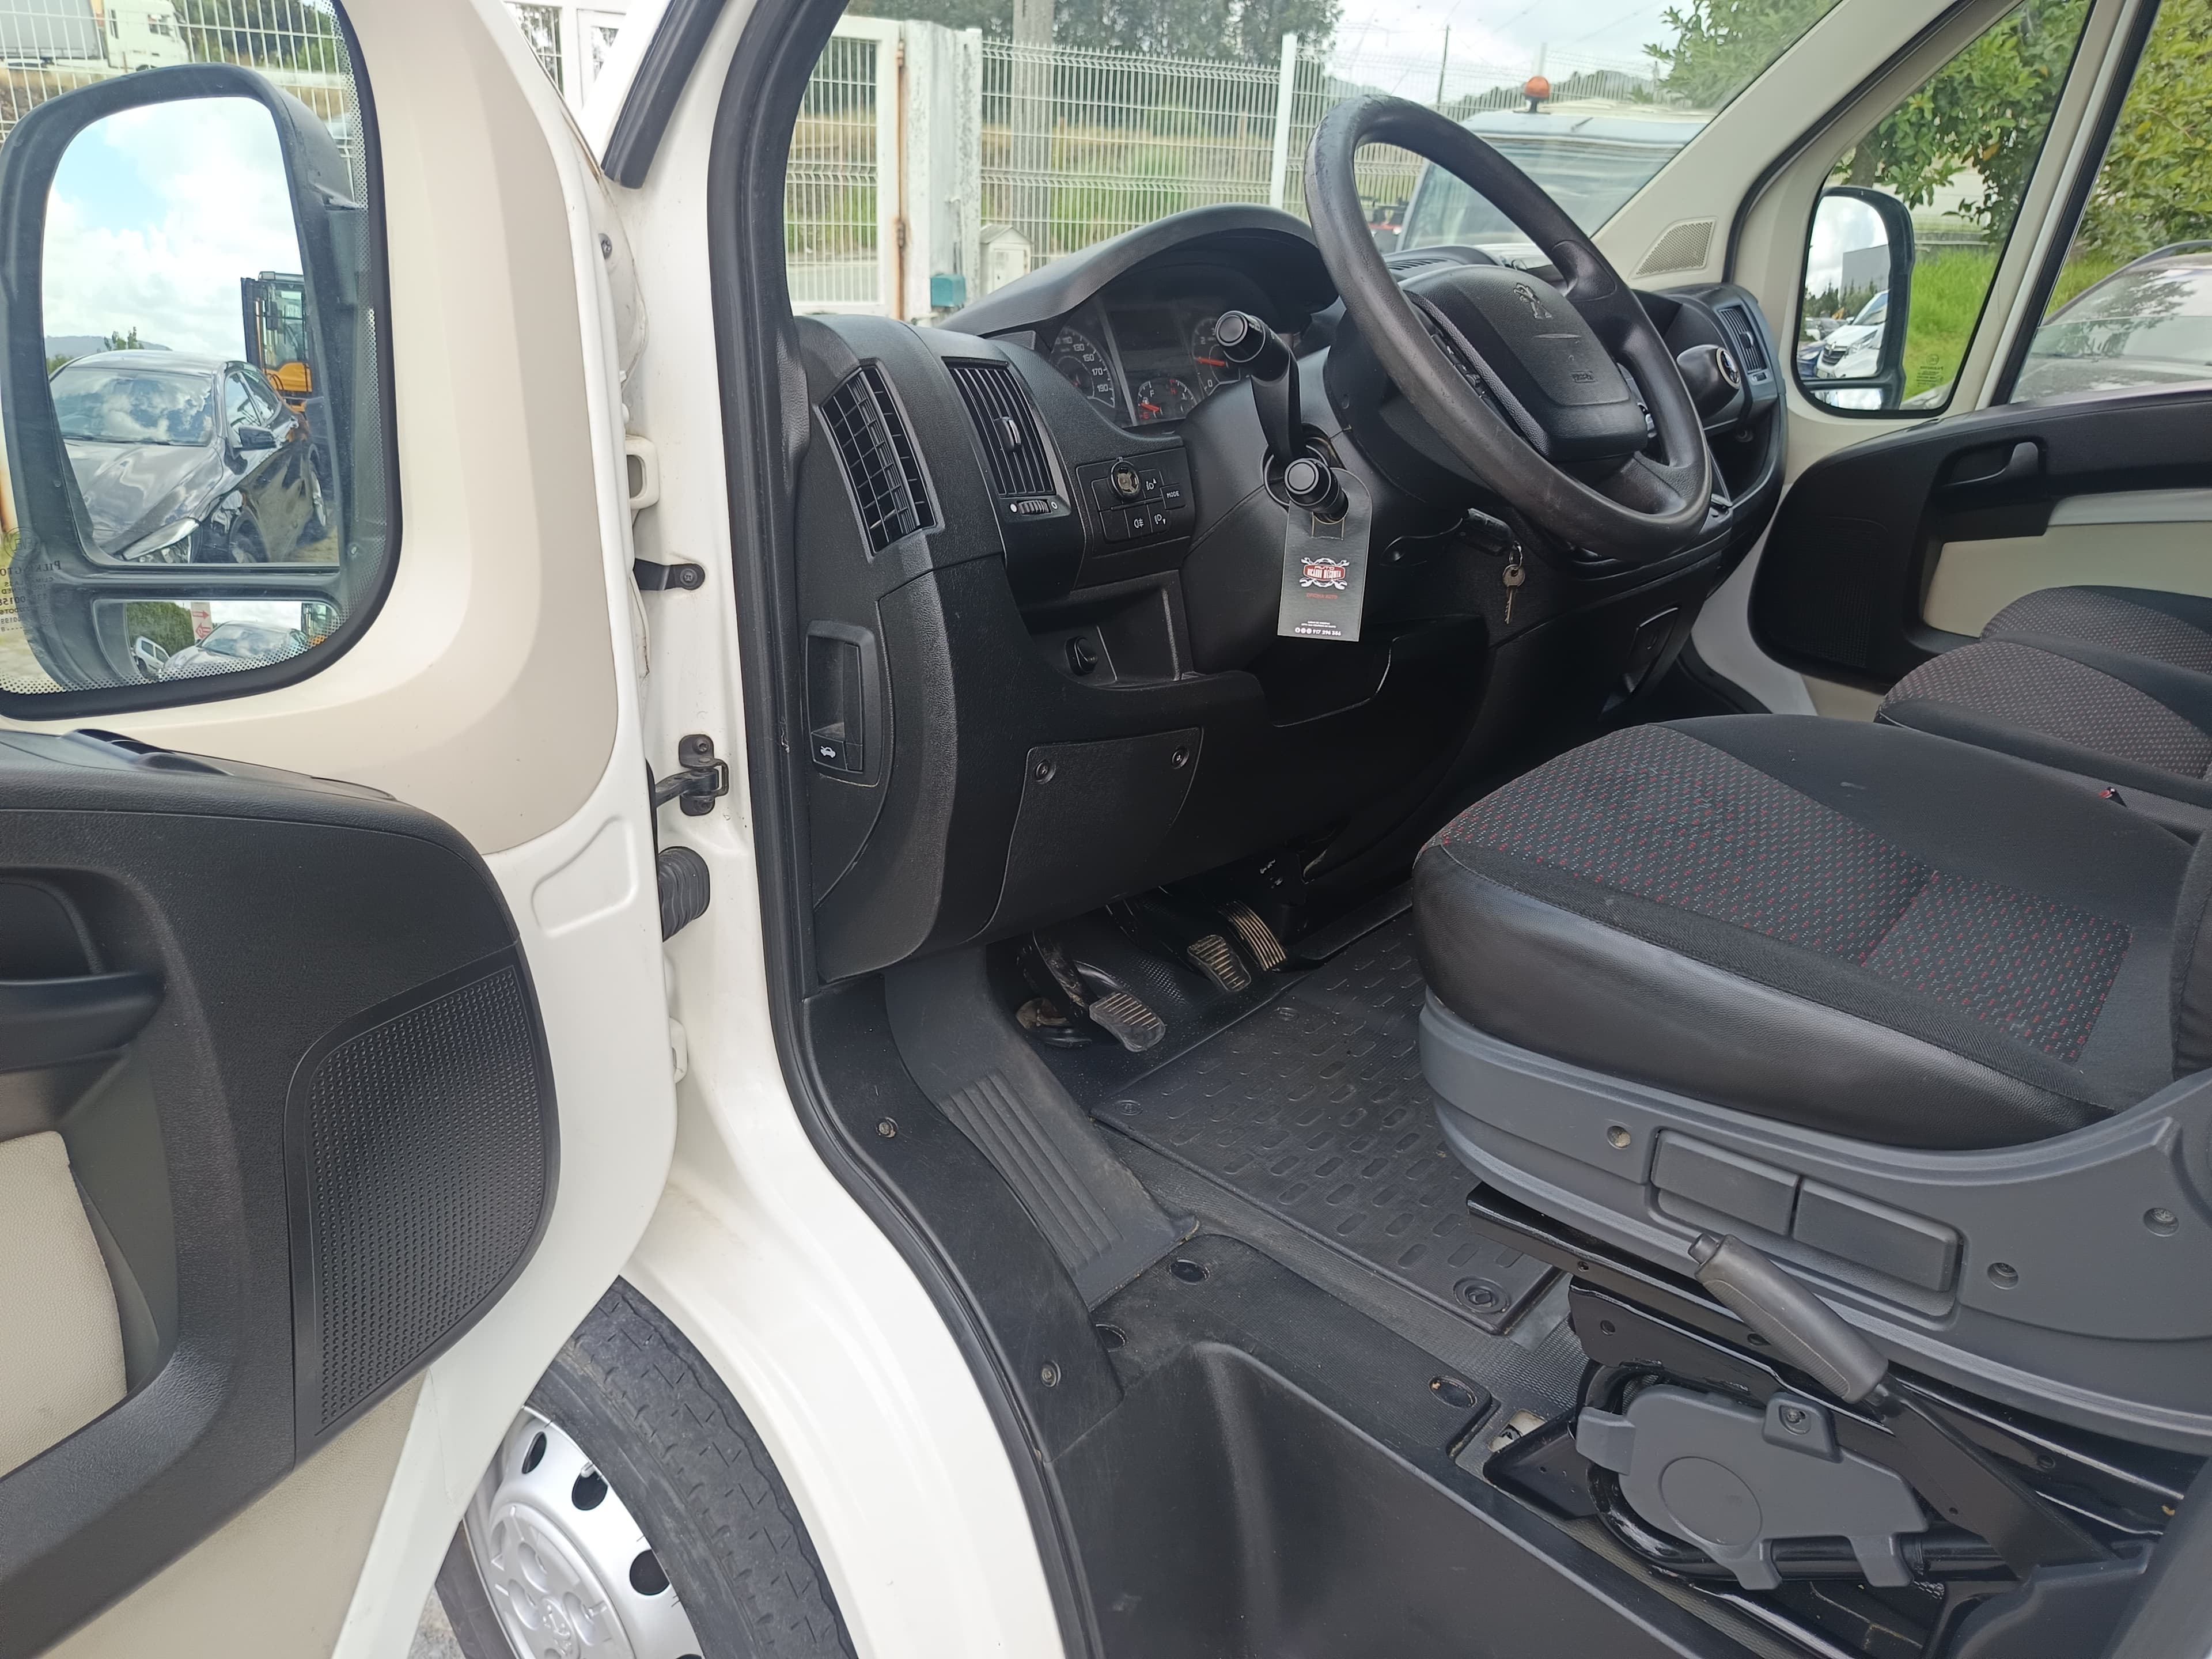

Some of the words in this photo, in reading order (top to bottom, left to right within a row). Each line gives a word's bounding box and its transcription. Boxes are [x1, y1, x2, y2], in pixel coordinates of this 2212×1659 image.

[1092, 368, 1103, 376] 170
[1097, 384, 1108, 392] 190
[1150, 389, 1154, 397] F
[1166, 490, 1180, 498] MODE
